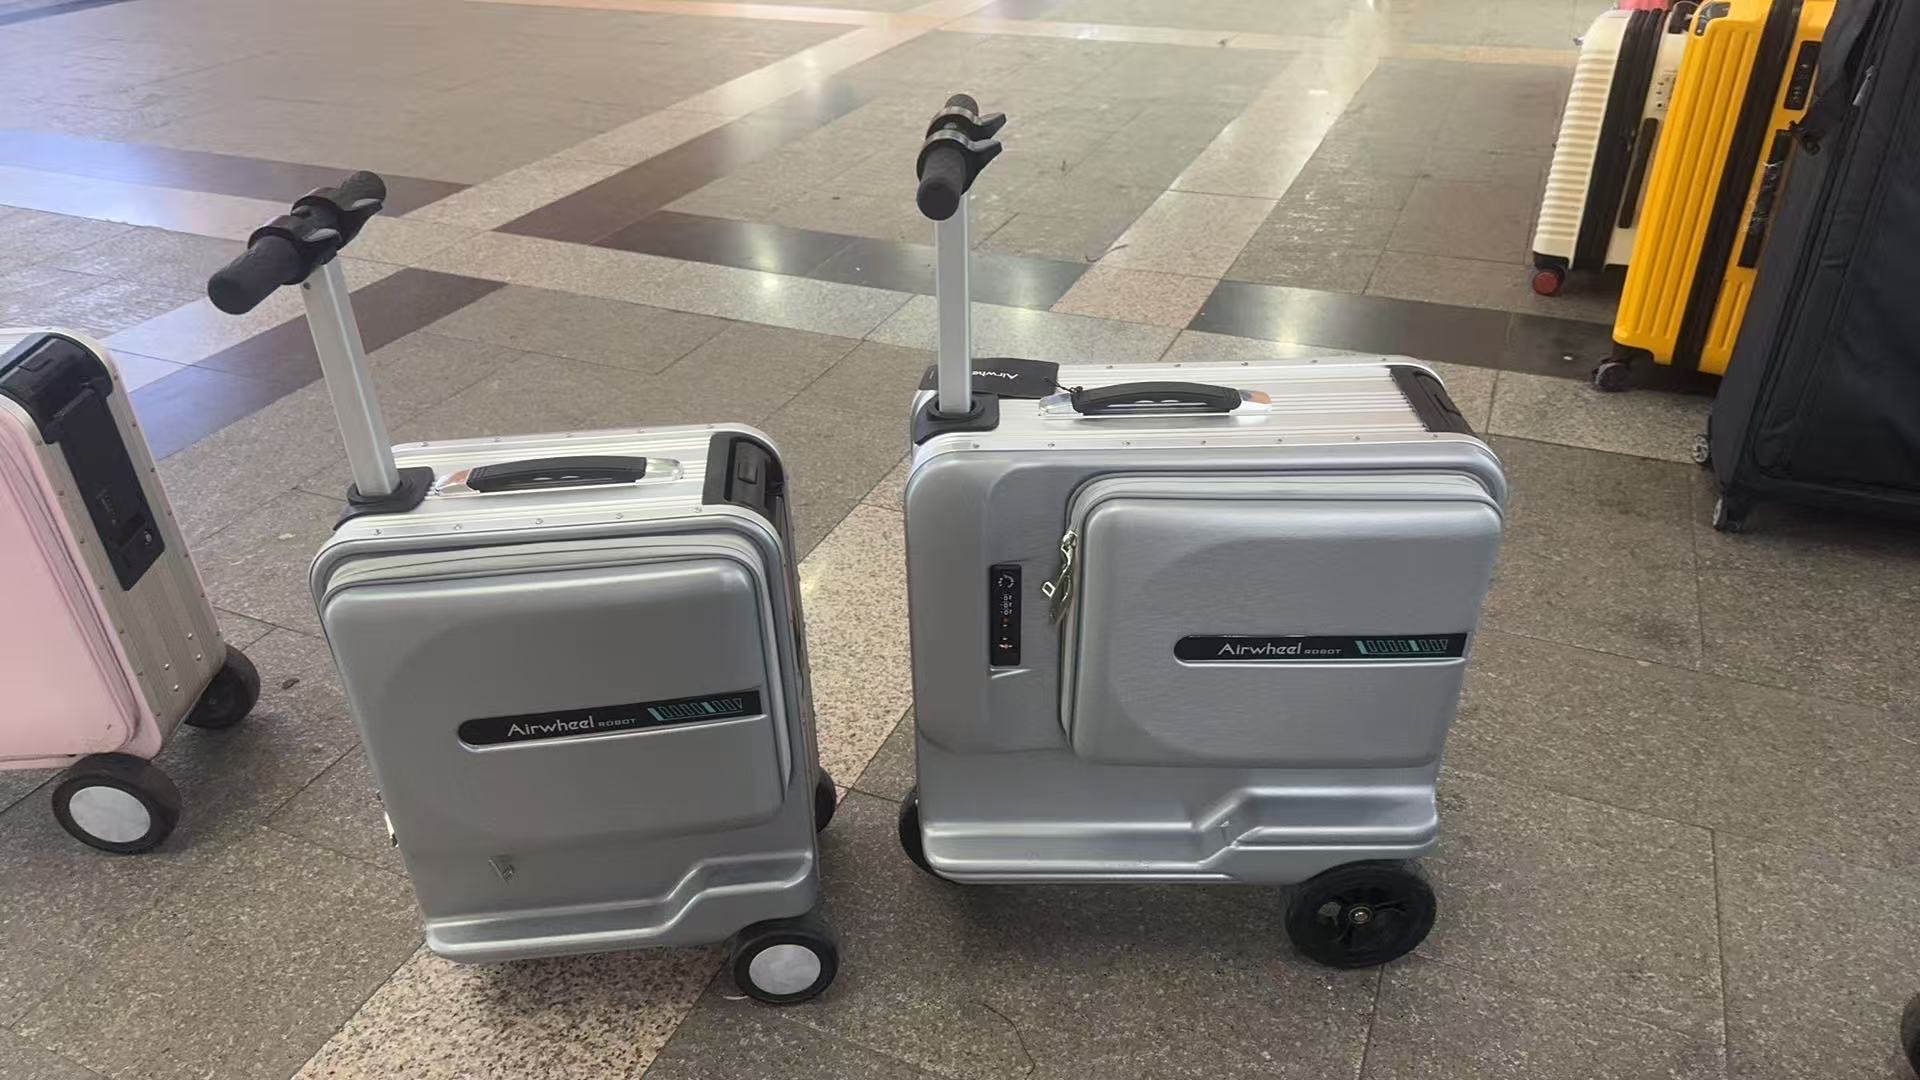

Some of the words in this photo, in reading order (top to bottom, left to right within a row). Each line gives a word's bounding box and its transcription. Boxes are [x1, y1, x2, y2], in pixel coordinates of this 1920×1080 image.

[972, 370, 1018, 380] Airwhe
[1217, 642, 1302, 655] Airwheel
[507, 715, 595, 737] Airwheel
[598, 718, 637, 727] ROBOT
